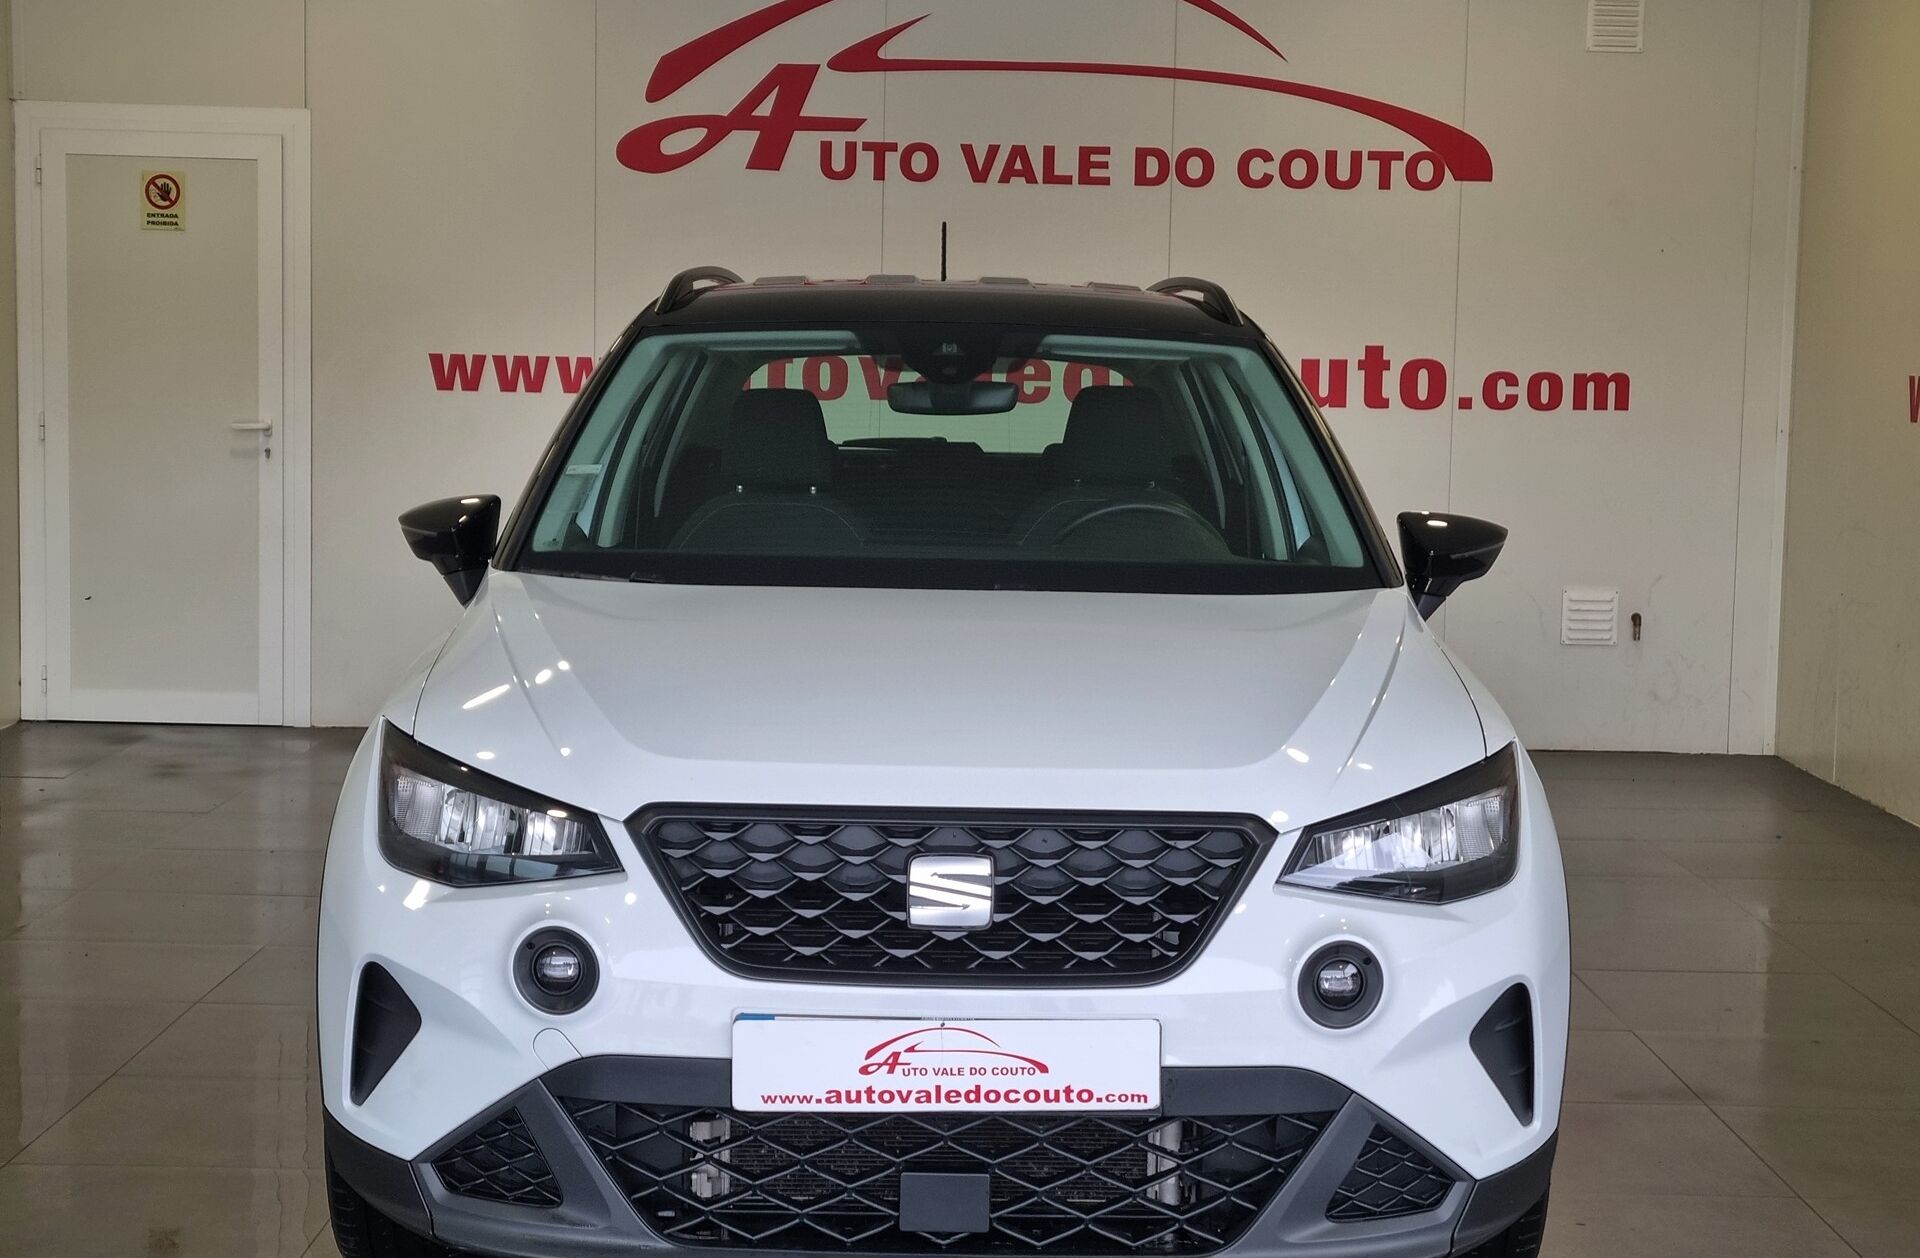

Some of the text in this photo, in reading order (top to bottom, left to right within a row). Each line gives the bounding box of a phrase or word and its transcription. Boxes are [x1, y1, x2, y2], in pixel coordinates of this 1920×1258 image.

[960, 144, 1111, 186] VALE
[1134, 147, 1215, 188] DO
[1237, 148, 1445, 191] COUTO
[932, 1067, 965, 1077] VALE
[968, 1067, 988, 1077] DO
[991, 1066, 1036, 1077] COUTO
[760, 1084, 1149, 1105] www.autovaledocouto.com
